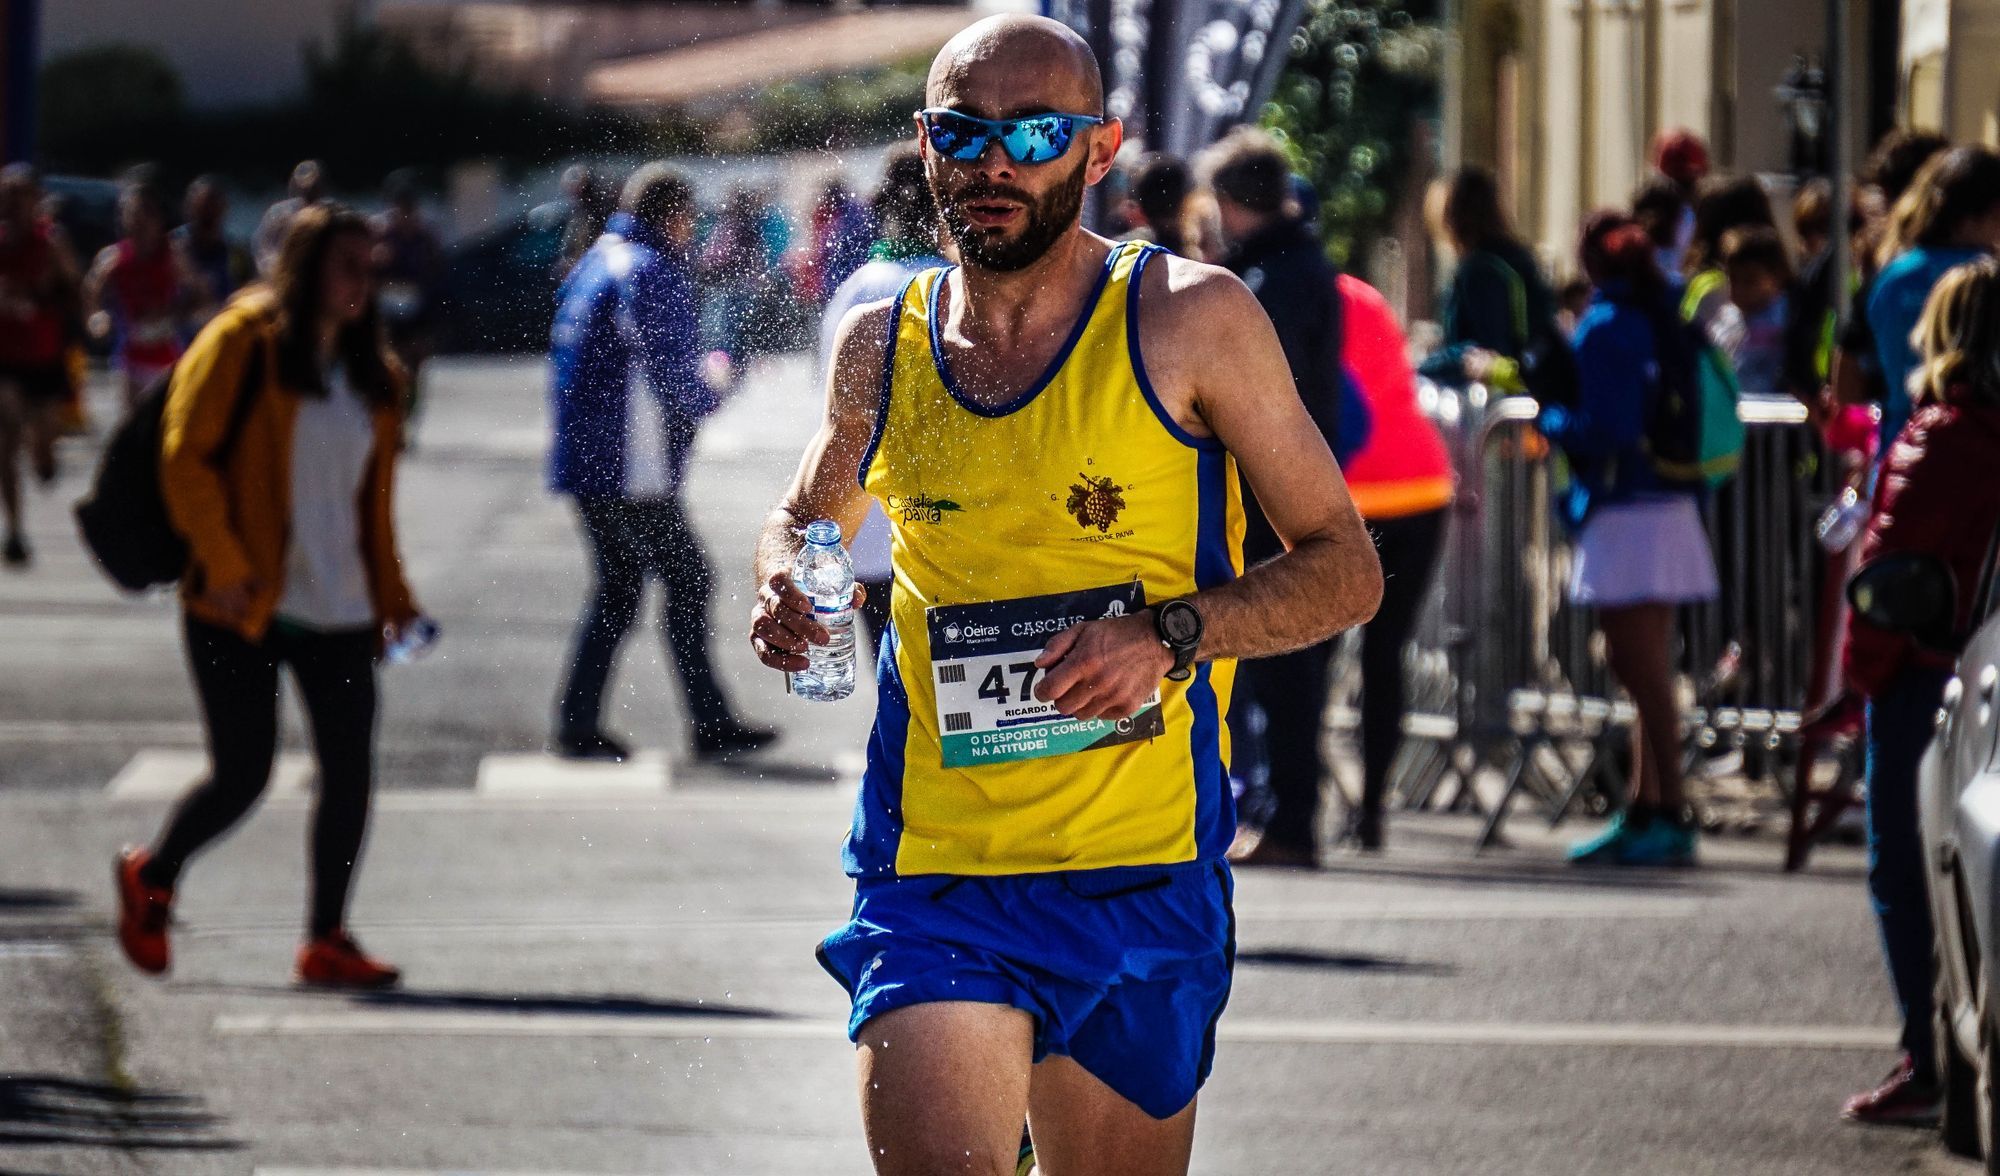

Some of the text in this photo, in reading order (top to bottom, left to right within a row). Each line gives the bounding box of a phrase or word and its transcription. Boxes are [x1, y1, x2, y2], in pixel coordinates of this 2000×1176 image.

[887, 493, 933, 508] Castelo
[903, 508, 941, 526] paiva
[963, 625, 1000, 638] Oeiras
[978, 661, 1040, 704] 47
[1005, 705, 1048, 717] RICARDO
[970, 735, 980, 745] O
[983, 727, 1048, 744] DESPORTO
[1051, 719, 1105, 736] COMEÇA
[971, 740, 1048, 757] NA ATITUDE!
